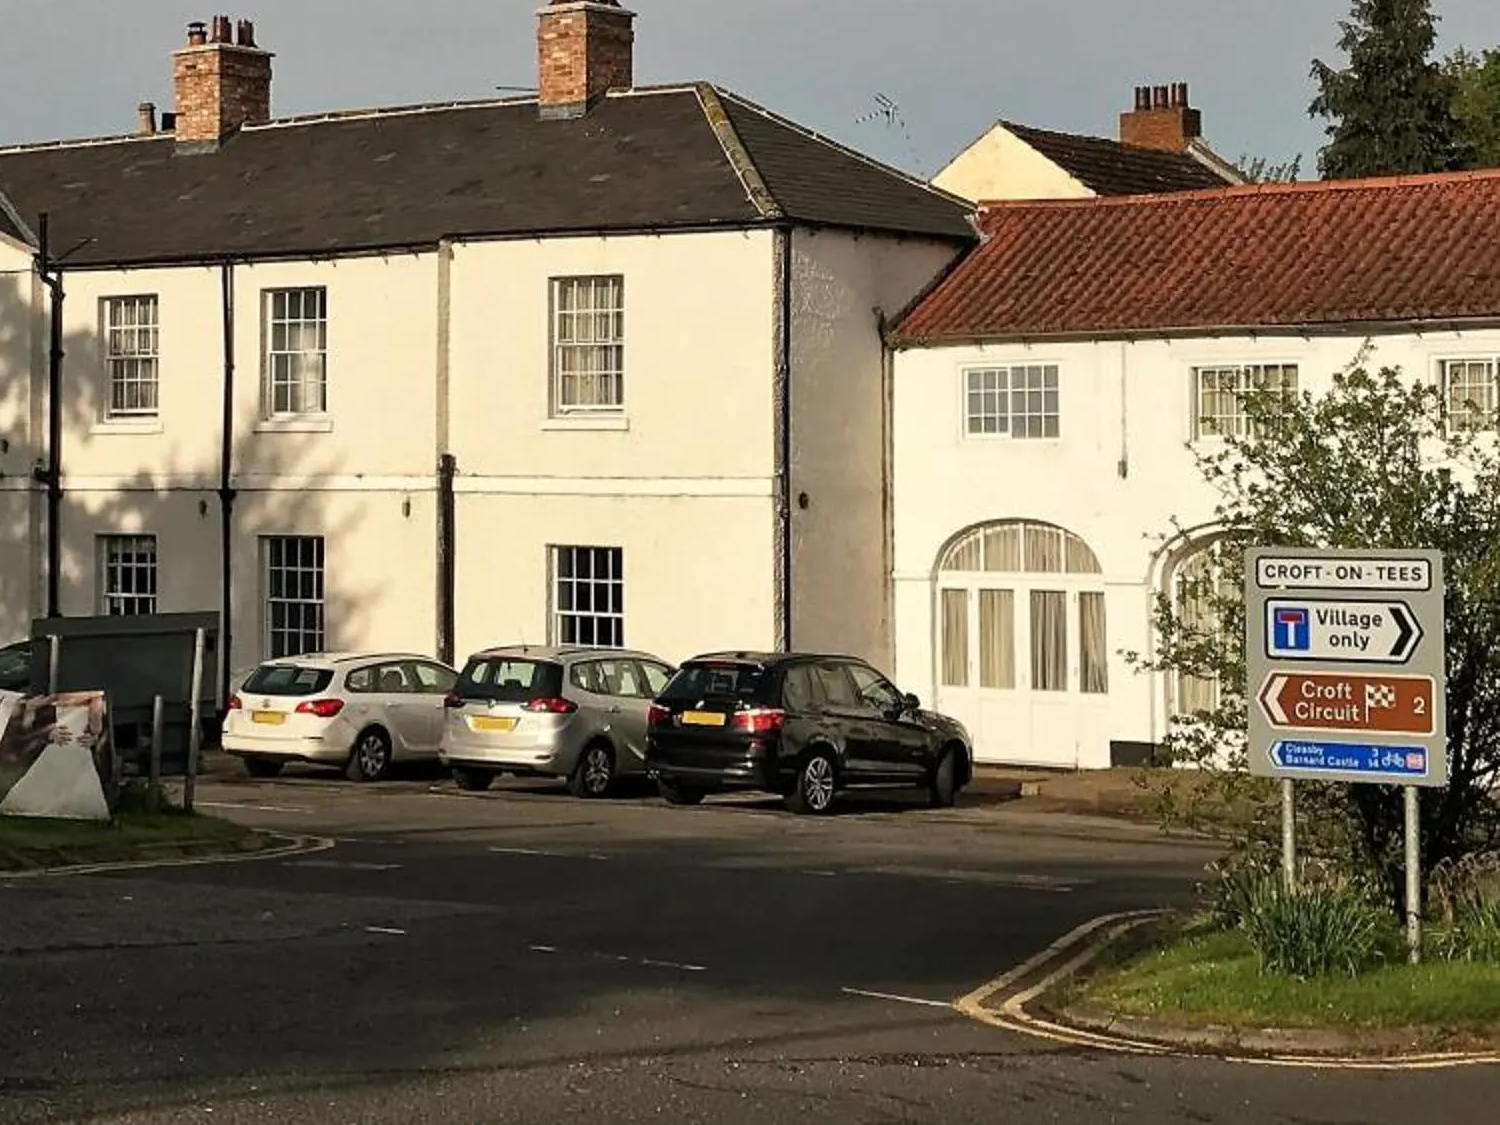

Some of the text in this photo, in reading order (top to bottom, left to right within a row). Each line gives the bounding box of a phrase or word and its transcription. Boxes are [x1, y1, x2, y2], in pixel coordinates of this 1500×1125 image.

[1316, 608, 1383, 629] Village
[1329, 632, 1370, 650] only
[1301, 681, 1352, 700] Croft
[1295, 697, 1425, 722] Circuit 2
[1328, 756, 1360, 768] Castle
